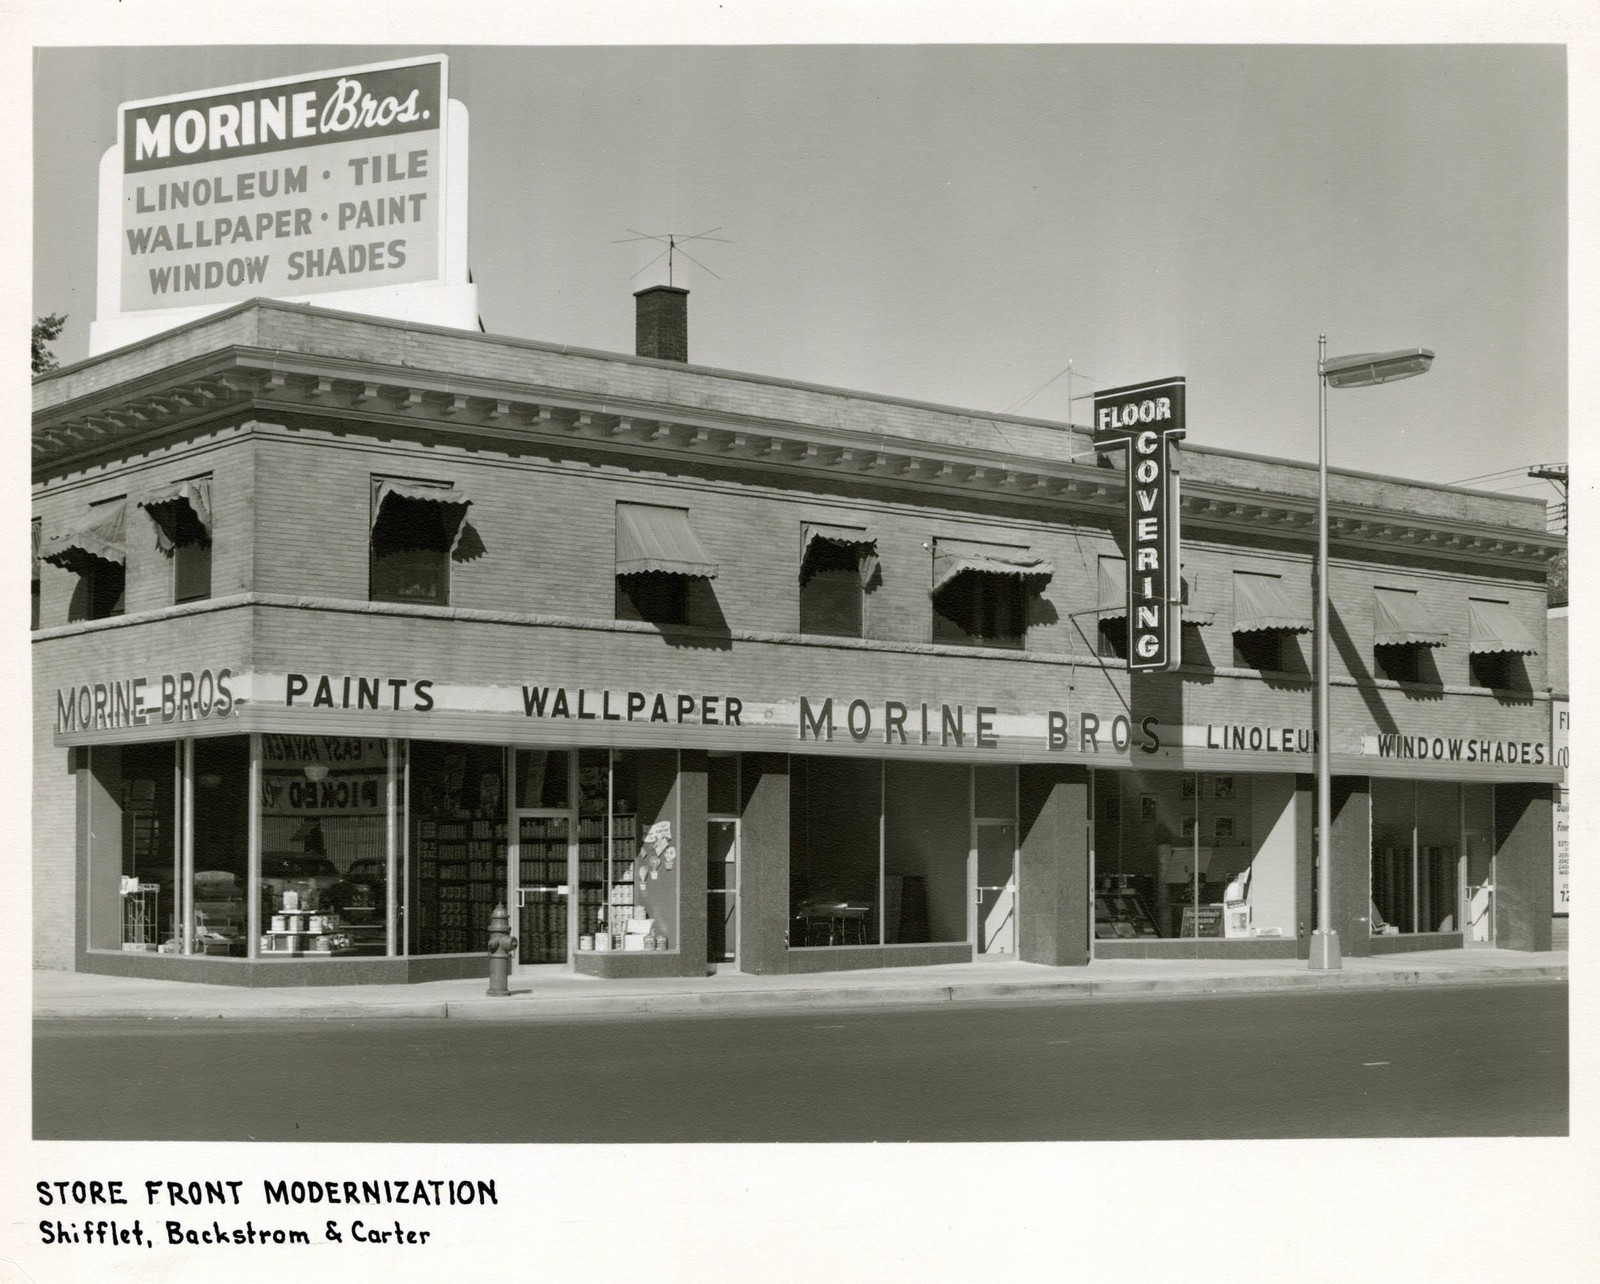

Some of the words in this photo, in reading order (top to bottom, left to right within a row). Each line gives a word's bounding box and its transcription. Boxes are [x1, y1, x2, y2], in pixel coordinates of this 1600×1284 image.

[135, 91, 317, 161] MORINE
[320, 77, 430, 133] Bros.
[136, 165, 308, 214] LINOLEUM
[348, 149, 428, 186] TILE
[127, 208, 312, 256] WALLPAPER
[338, 193, 427, 231] PAINT
[149, 255, 269, 295] WINDOW
[287, 239, 406, 281] SHADES
[1098, 397, 1171, 430] FLOOR
[1135, 430, 1159, 658] COVERING
[57, 677, 148, 733] MORINE
[285, 673, 434, 712] PAINTS
[522, 686, 743, 726] WALLPAPER
[799, 696, 998, 748] MORINE
